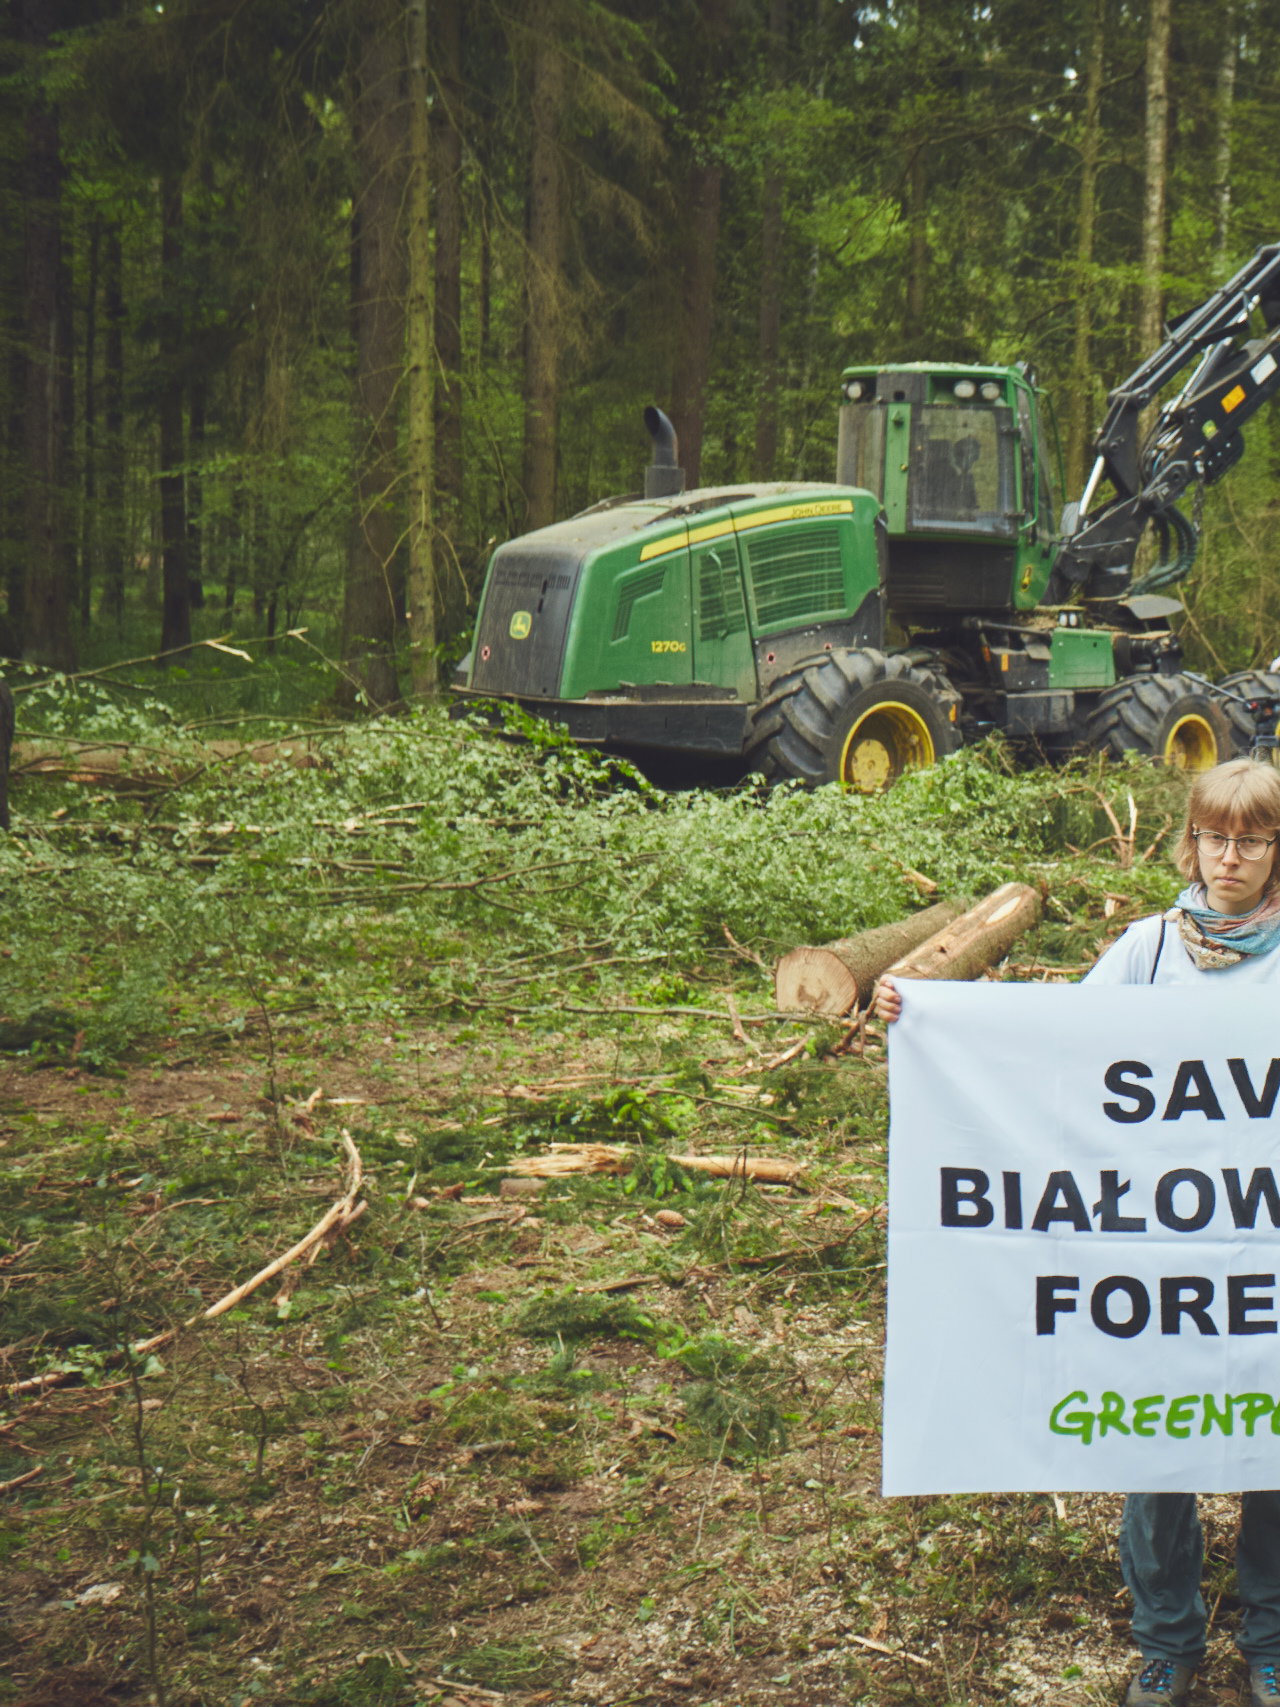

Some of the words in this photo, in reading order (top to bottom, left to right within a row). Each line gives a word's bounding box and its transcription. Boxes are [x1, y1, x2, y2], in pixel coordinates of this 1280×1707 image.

[790, 505, 813, 518] JOHN
[814, 502, 842, 515] DEERE
[651, 640, 687, 654] 1270G
